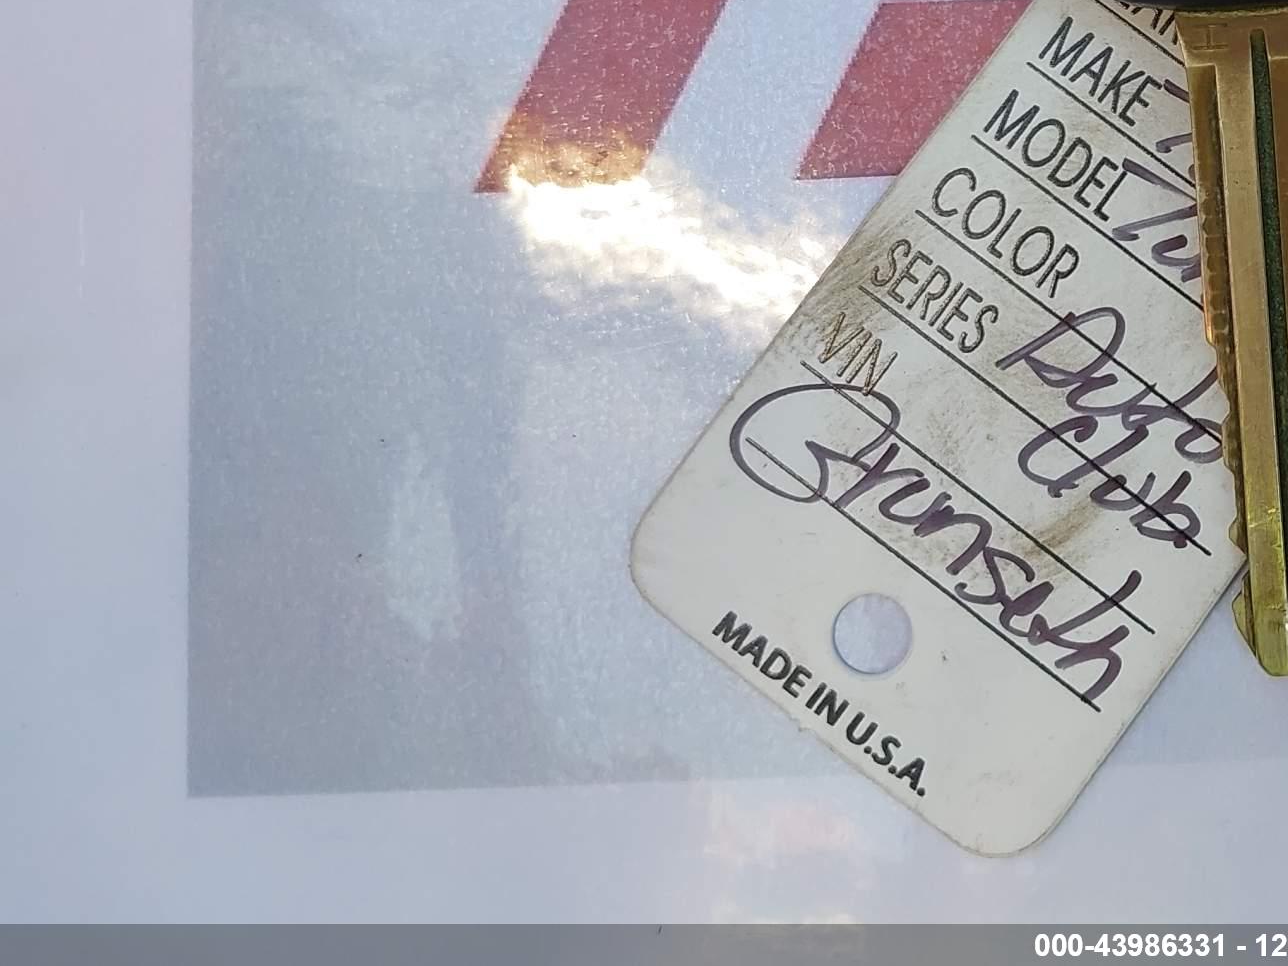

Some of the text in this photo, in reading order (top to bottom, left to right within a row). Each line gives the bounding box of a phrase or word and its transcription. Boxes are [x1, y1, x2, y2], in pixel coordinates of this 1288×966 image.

[1038, 17, 1163, 127] MAKE
[983, 89, 1128, 222] MODEL
[931, 167, 1080, 298] COLOR
[818, 312, 899, 396] VIN
[870, 238, 999, 354] SERIES
[712, 610, 926, 797] MADE IN U.S.A.
